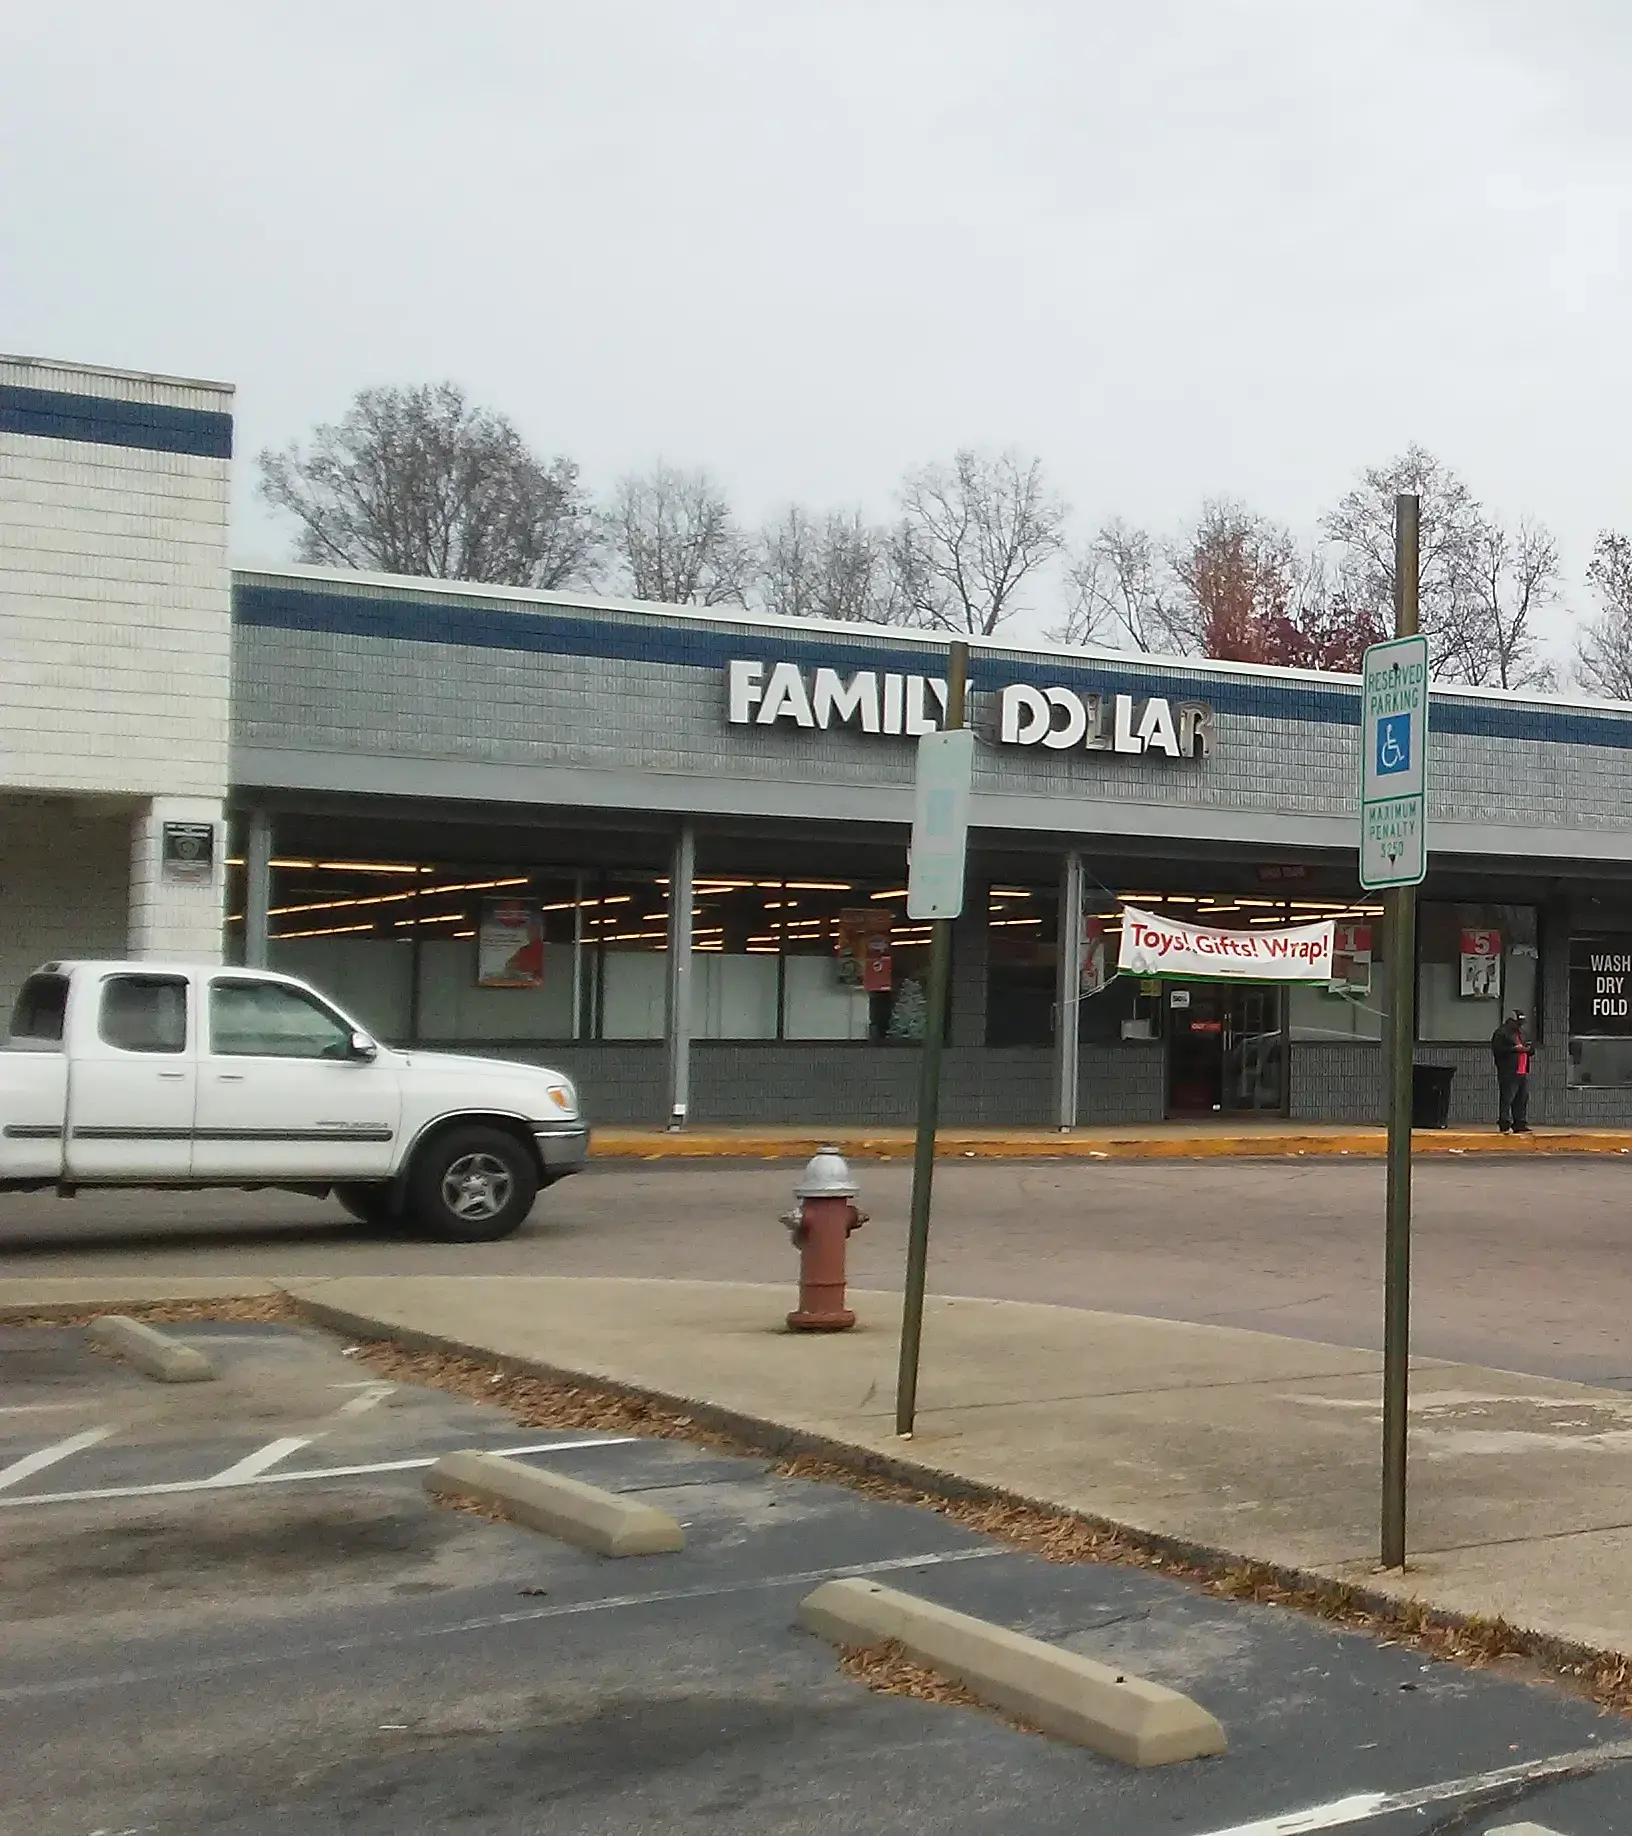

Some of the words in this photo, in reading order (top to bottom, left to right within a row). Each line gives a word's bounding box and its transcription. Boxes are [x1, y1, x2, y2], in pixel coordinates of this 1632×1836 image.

[1368, 663, 1423, 693] RESERVED
[1370, 693, 1419, 716] PARKING
[1001, 684, 1215, 758] DOLLAR
[1369, 806, 1417, 823] MAXIMUM
[1369, 821, 1415, 841] PENALTY
[1381, 841, 1404, 858] $250
[1129, 923, 1190, 957] Toys!
[1195, 935, 1258, 958] Gifts!
[1262, 934, 1328, 965] Wrap!
[1591, 955, 1631, 972] WASH
[1596, 976, 1624, 994] DRY
[1593, 998, 1628, 1016] FOLD
